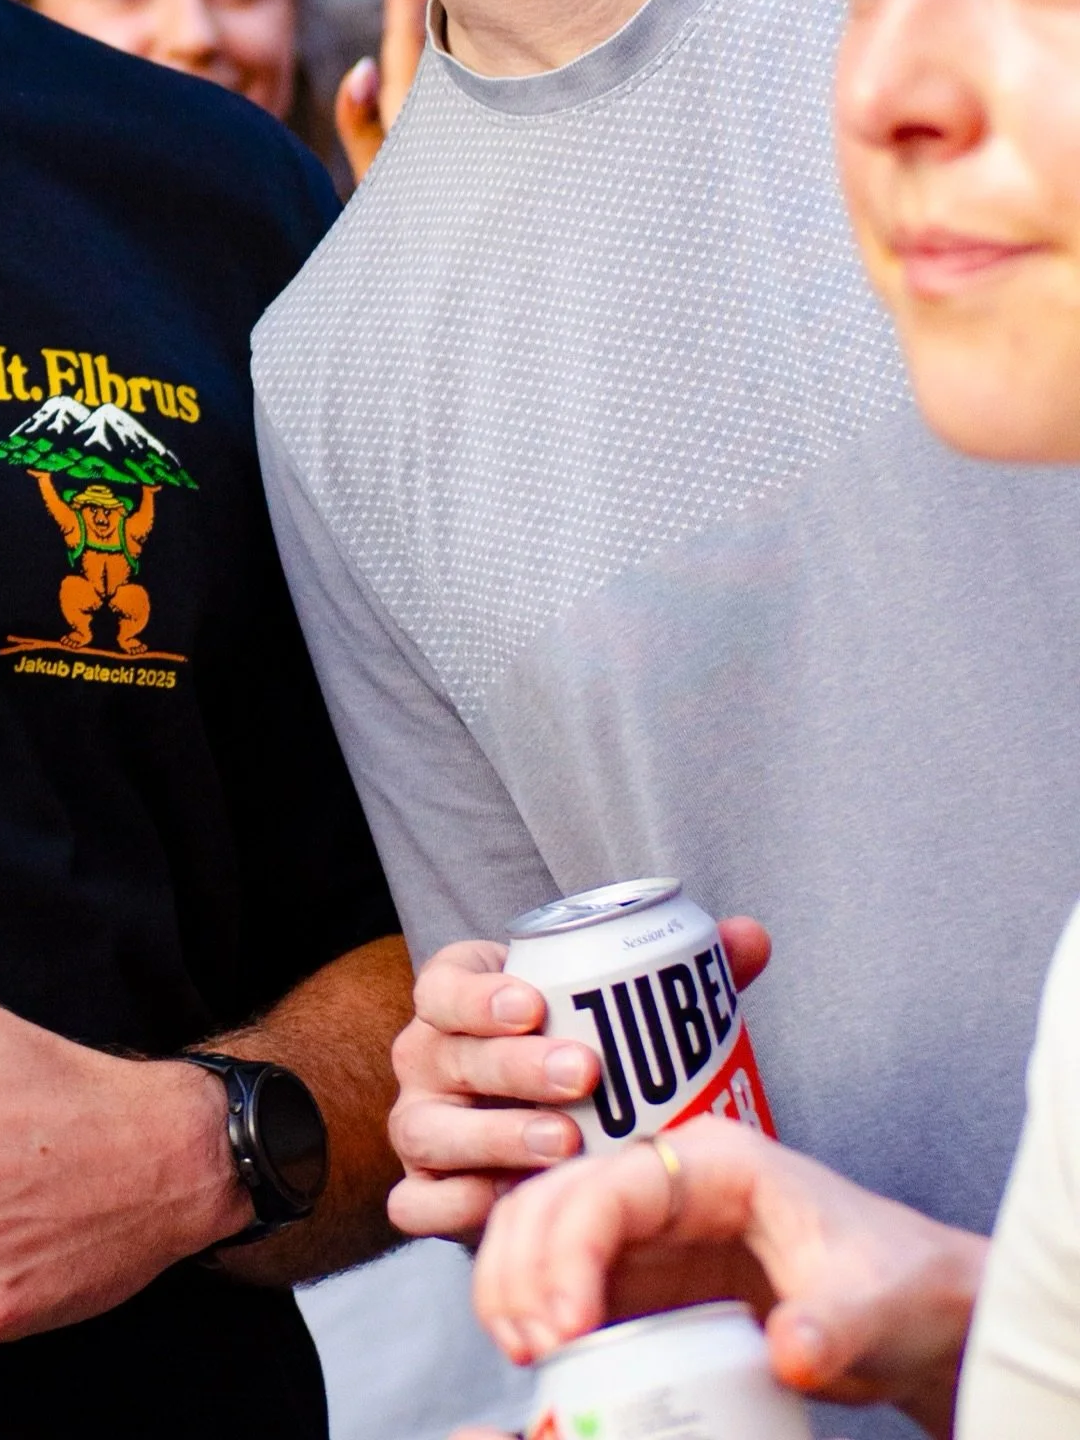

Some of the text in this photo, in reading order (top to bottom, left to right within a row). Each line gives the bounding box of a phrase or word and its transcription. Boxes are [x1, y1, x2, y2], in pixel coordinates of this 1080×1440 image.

[41, 348, 201, 424] Elbrus
[14, 656, 70, 678] Jakub
[135, 667, 177, 689] 2025
[622, 927, 666, 951] Session
